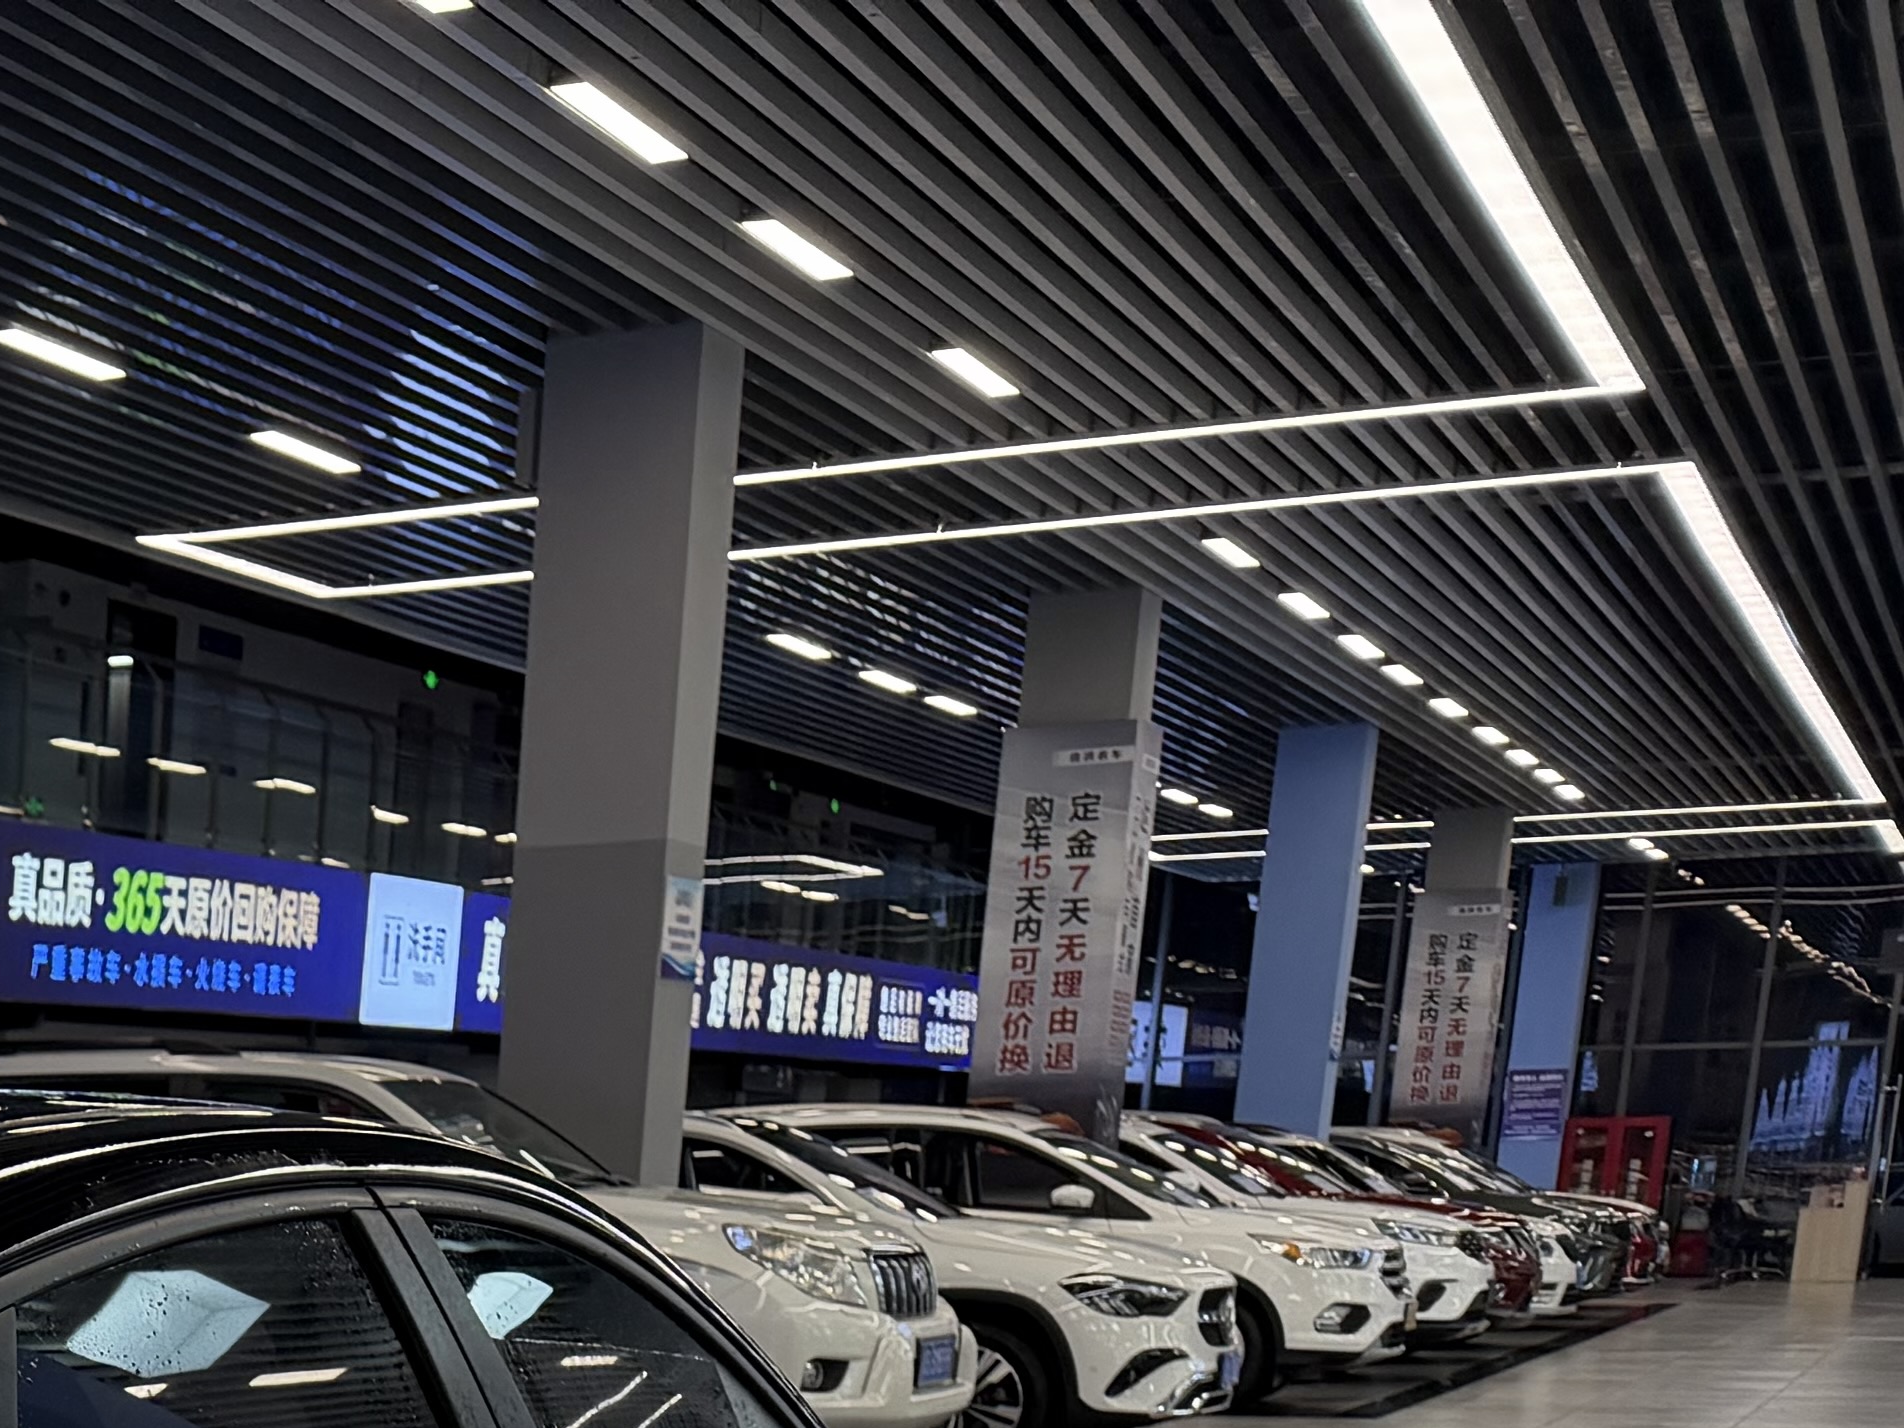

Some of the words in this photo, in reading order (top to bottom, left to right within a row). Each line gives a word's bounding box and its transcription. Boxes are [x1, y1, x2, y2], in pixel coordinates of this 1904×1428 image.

[8, 852, 320, 950] 真品质·365天原价回购保障
[998, 796, 1054, 1074] 购车15天内可原价换
[1044, 793, 1101, 1073] 定金7天无理由退
